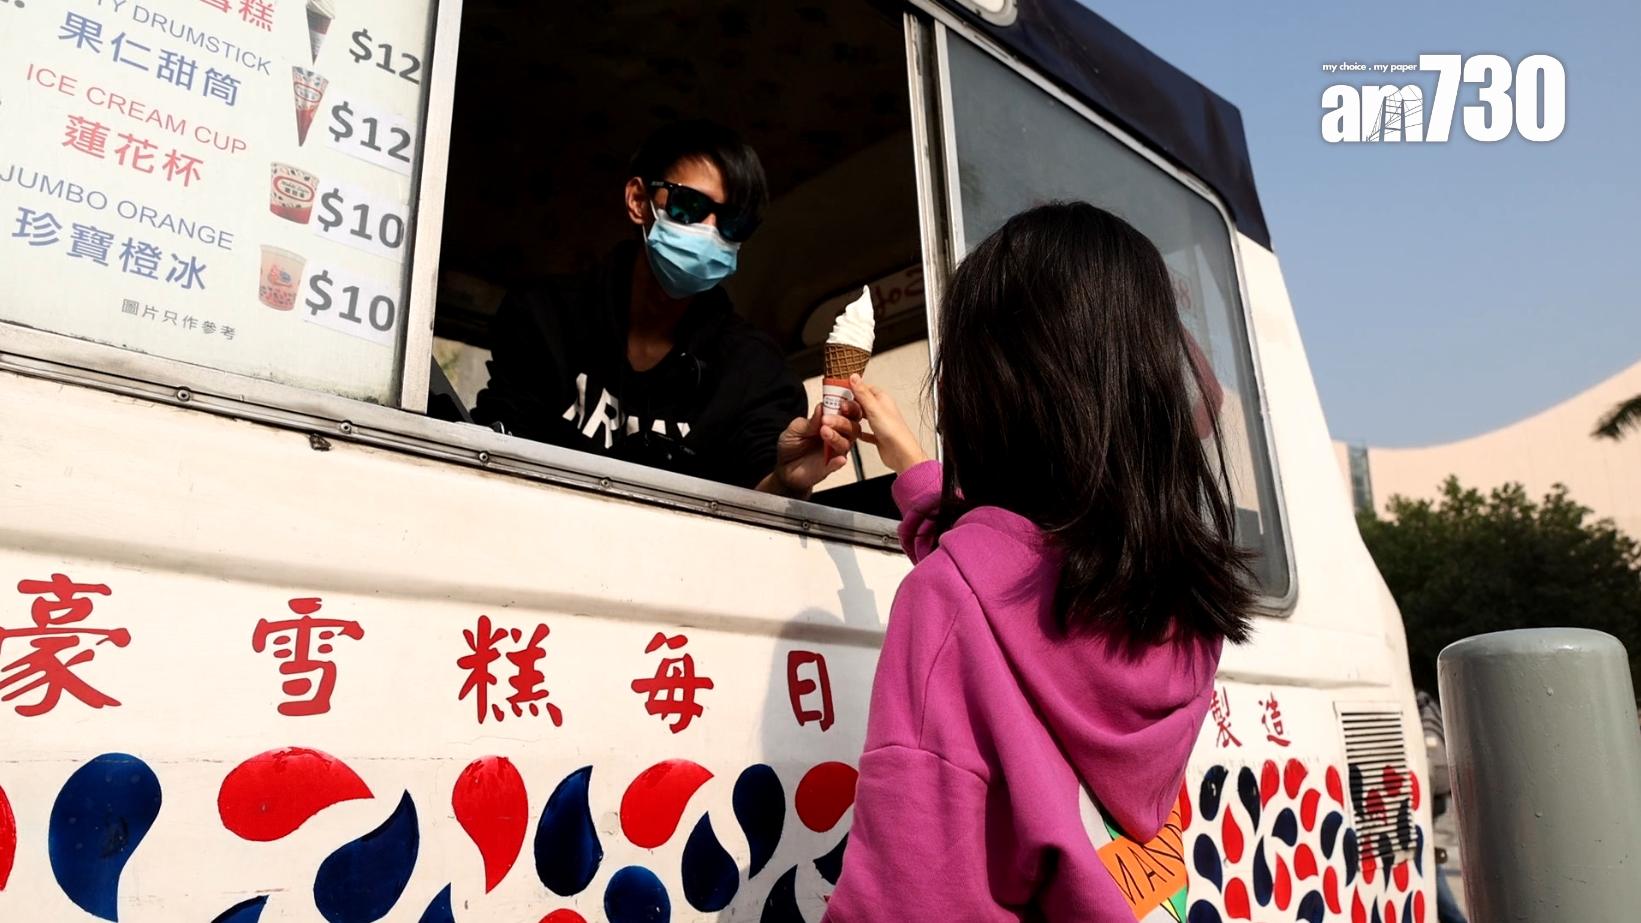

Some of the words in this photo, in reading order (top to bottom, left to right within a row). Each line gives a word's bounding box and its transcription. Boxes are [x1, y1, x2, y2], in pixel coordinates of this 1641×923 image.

[58, 11, 242, 107] 果仁甜筒
[132, 4, 272, 76] DRUMSTICK
[348, 28, 422, 86] $12
[26, 63, 76, 97] ICE
[86, 86, 187, 137] CREAM
[194, 125, 248, 155] CUP
[328, 101, 412, 164] $12
[62, 114, 204, 188] 蓮花杯
[0, 164, 108, 210] JUMBO
[117, 200, 235, 251] ORANGE
[317, 187, 405, 250] $10
[11, 206, 208, 291] 珍寶橙冰
[121, 298, 237, 341] 圖片只作參考
[304, 270, 396, 333] $10
[0, 573, 835, 733] 豪雪糕每日
